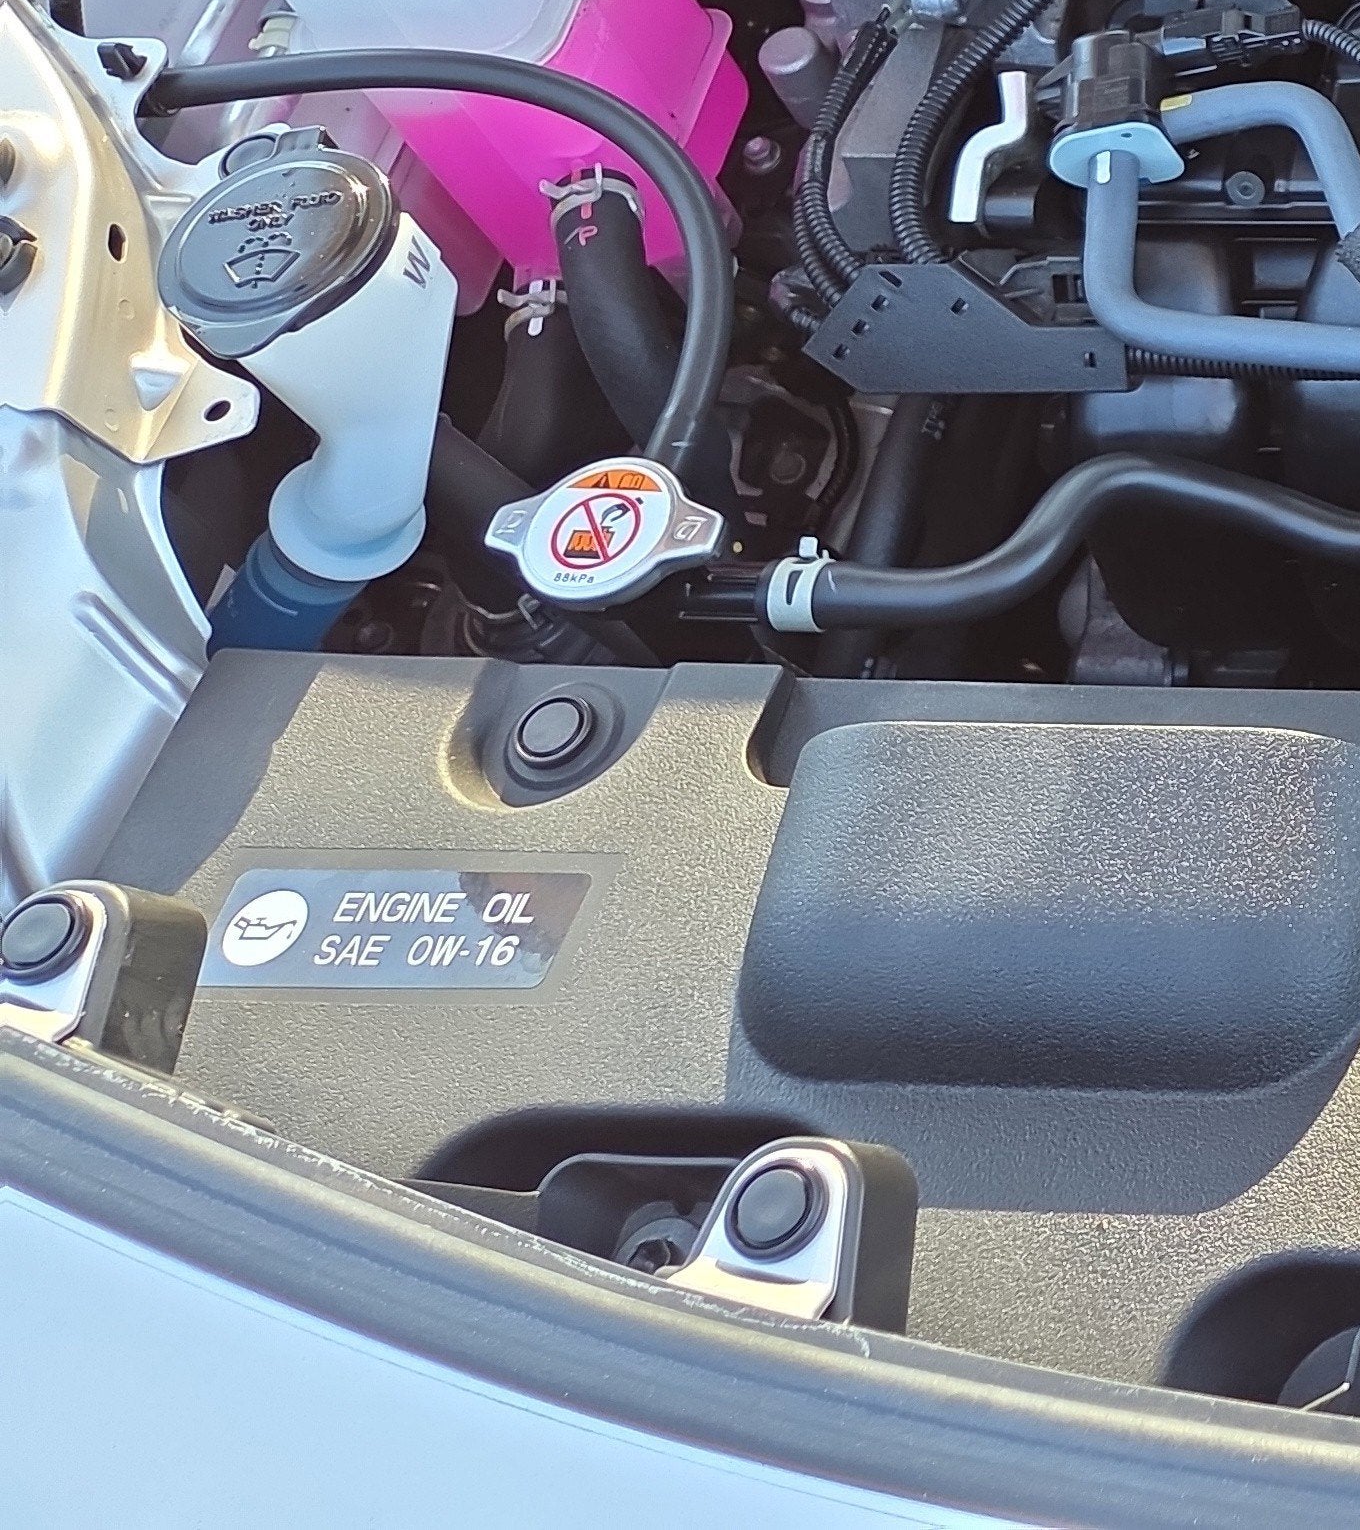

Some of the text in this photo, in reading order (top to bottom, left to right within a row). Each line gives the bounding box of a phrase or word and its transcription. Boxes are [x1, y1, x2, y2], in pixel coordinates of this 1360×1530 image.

[248, 213, 295, 232] ONLY
[553, 573, 595, 584] 88kPa
[332, 892, 535, 923] ENGINE OIL
[313, 934, 520, 967] SAE 0W-16
